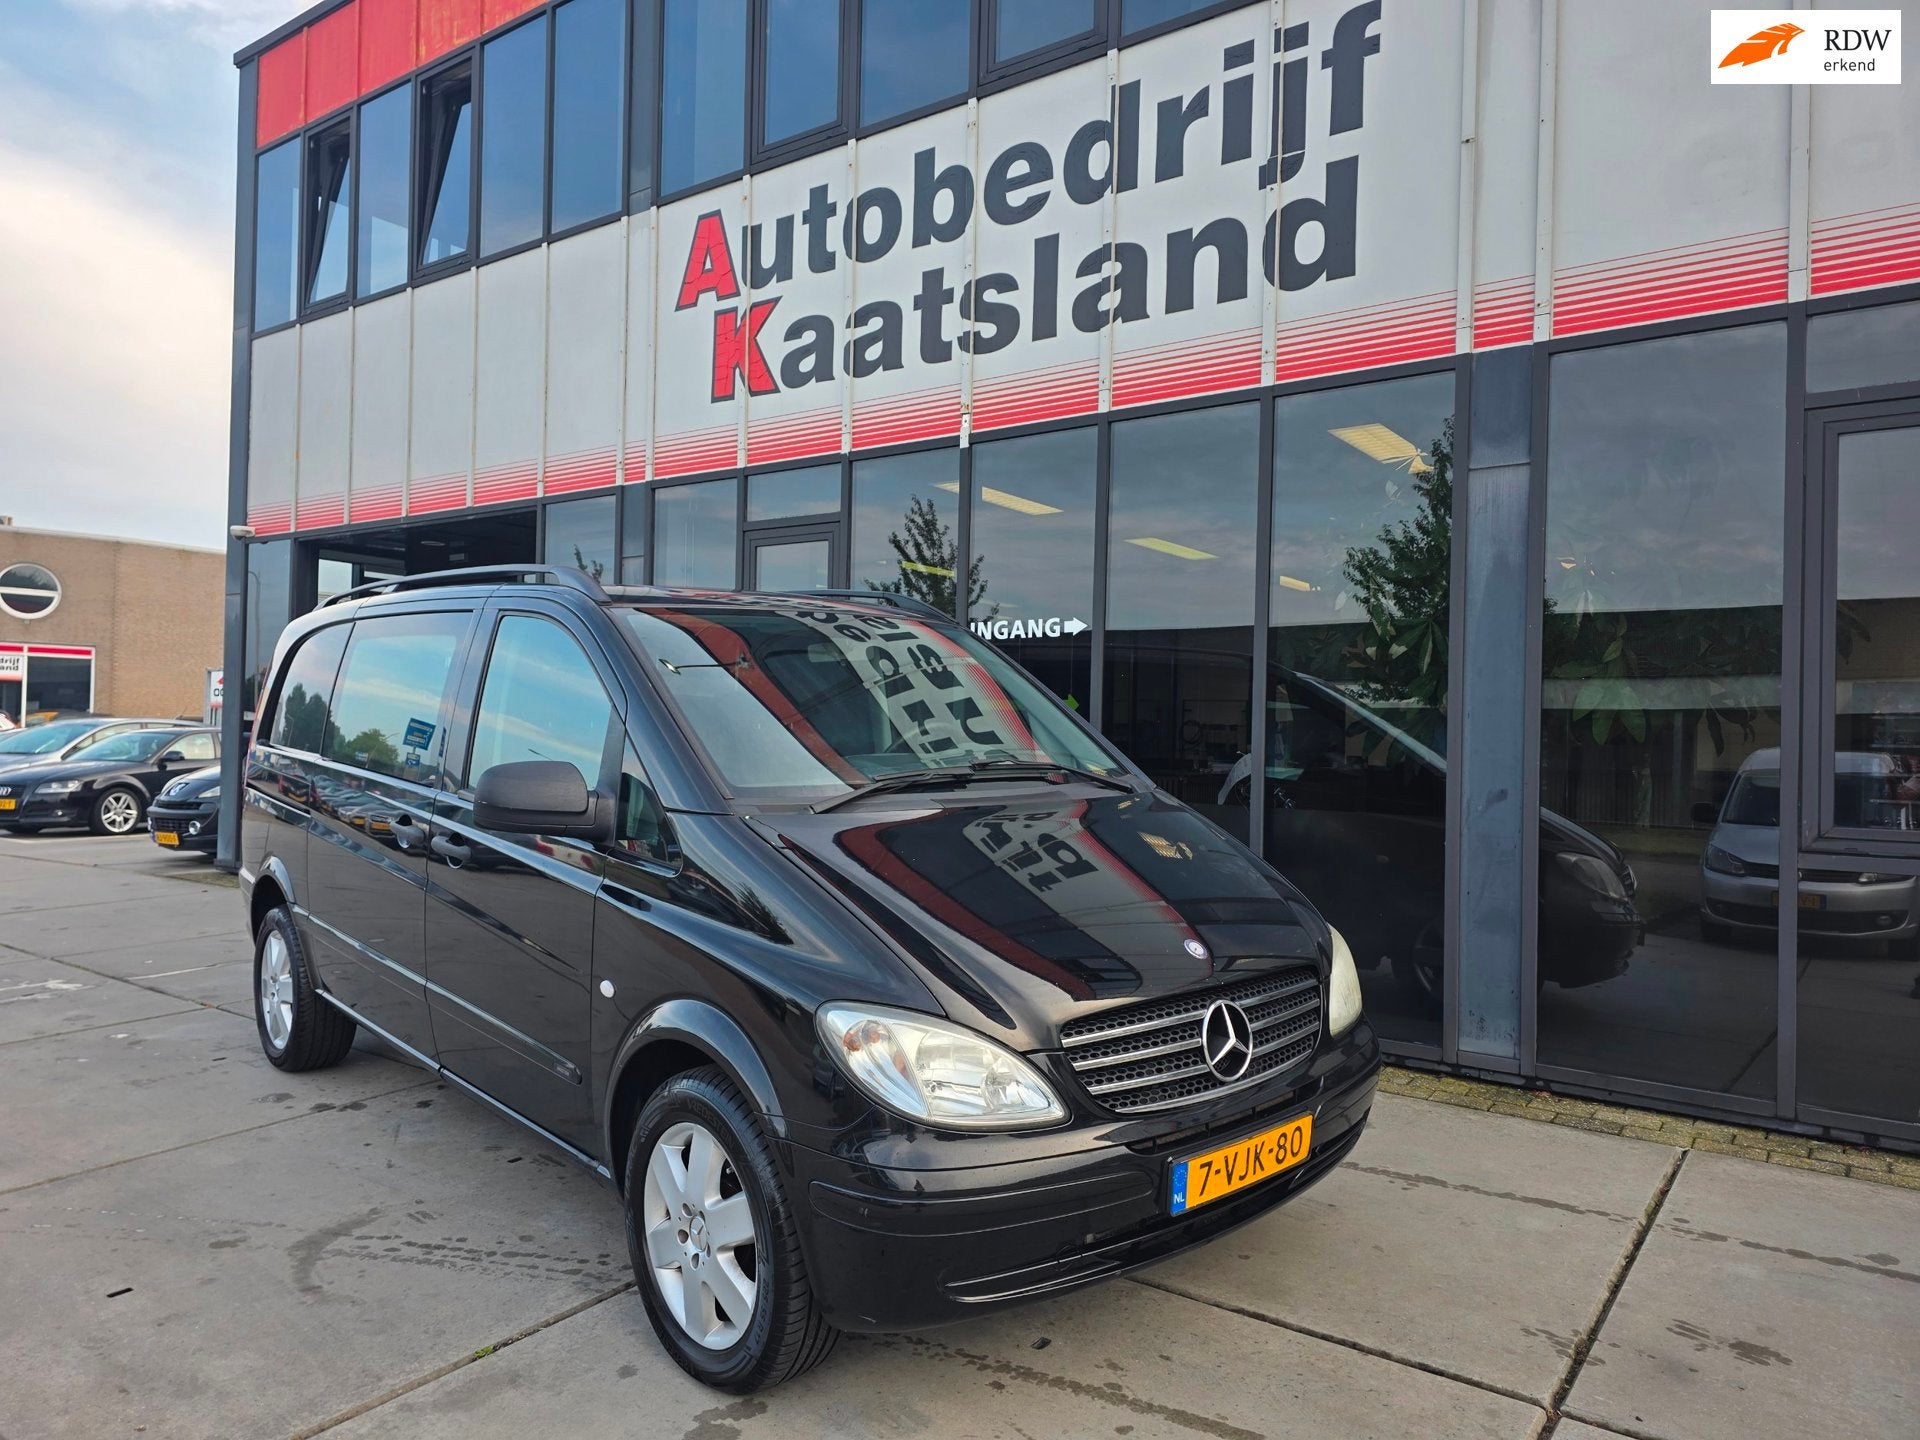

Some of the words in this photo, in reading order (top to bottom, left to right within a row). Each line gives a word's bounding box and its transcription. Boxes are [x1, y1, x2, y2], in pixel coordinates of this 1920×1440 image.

[675, 0, 1383, 311] Autobedrijf
[710, 155, 1359, 403] Kaatsland
[1173, 1193, 1185, 1203] NL
[1199, 1125, 1303, 1197] 7-VJK-80
